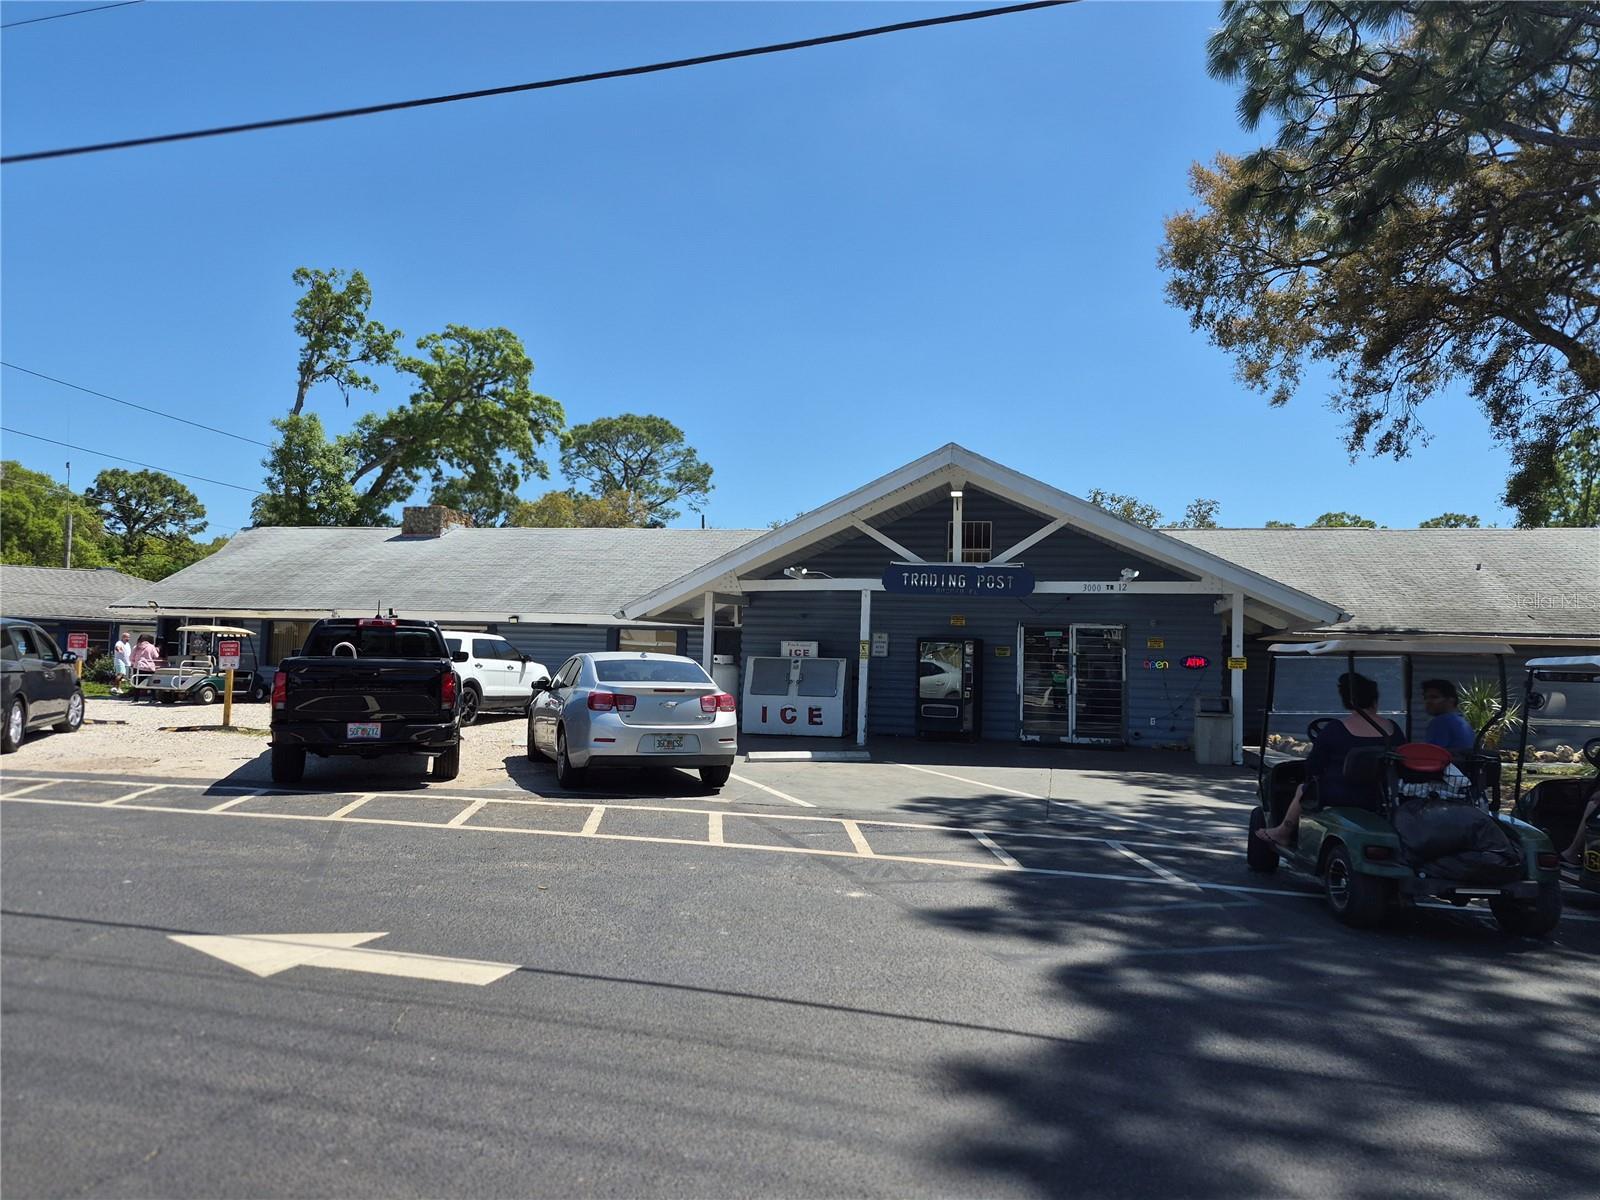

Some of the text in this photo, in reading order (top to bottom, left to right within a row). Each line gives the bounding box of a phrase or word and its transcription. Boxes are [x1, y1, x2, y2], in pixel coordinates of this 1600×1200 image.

[902, 573, 1014, 590] TRADING POST
[1082, 583, 1102, 592] 3000
[1118, 583, 1128, 592] 12
[789, 648, 811, 657] ICE
[1186, 657, 1205, 667] ATM
[761, 704, 824, 726] ICE
